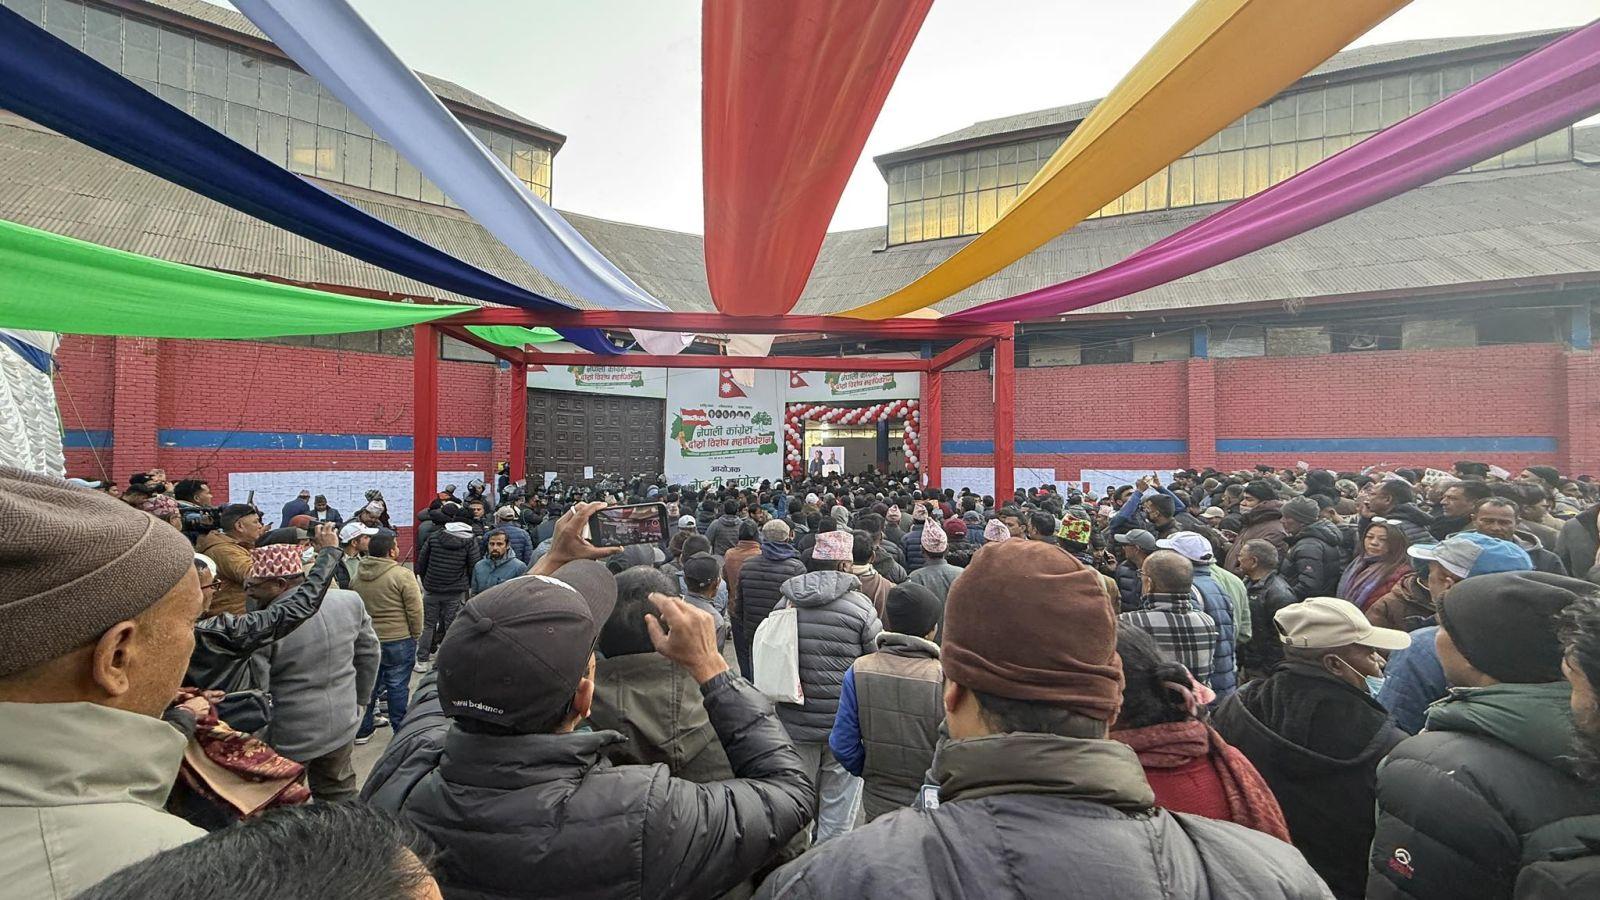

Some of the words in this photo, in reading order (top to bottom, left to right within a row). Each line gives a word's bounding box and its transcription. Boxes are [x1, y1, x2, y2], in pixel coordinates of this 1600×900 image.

[696, 425, 723, 437] नेपाली
[726, 424, 753, 436] कांग्रेस
[707, 437, 730, 448] विशेष
[731, 436, 772, 447] महाधिवेशन
[710, 464, 741, 473] आयोजक
